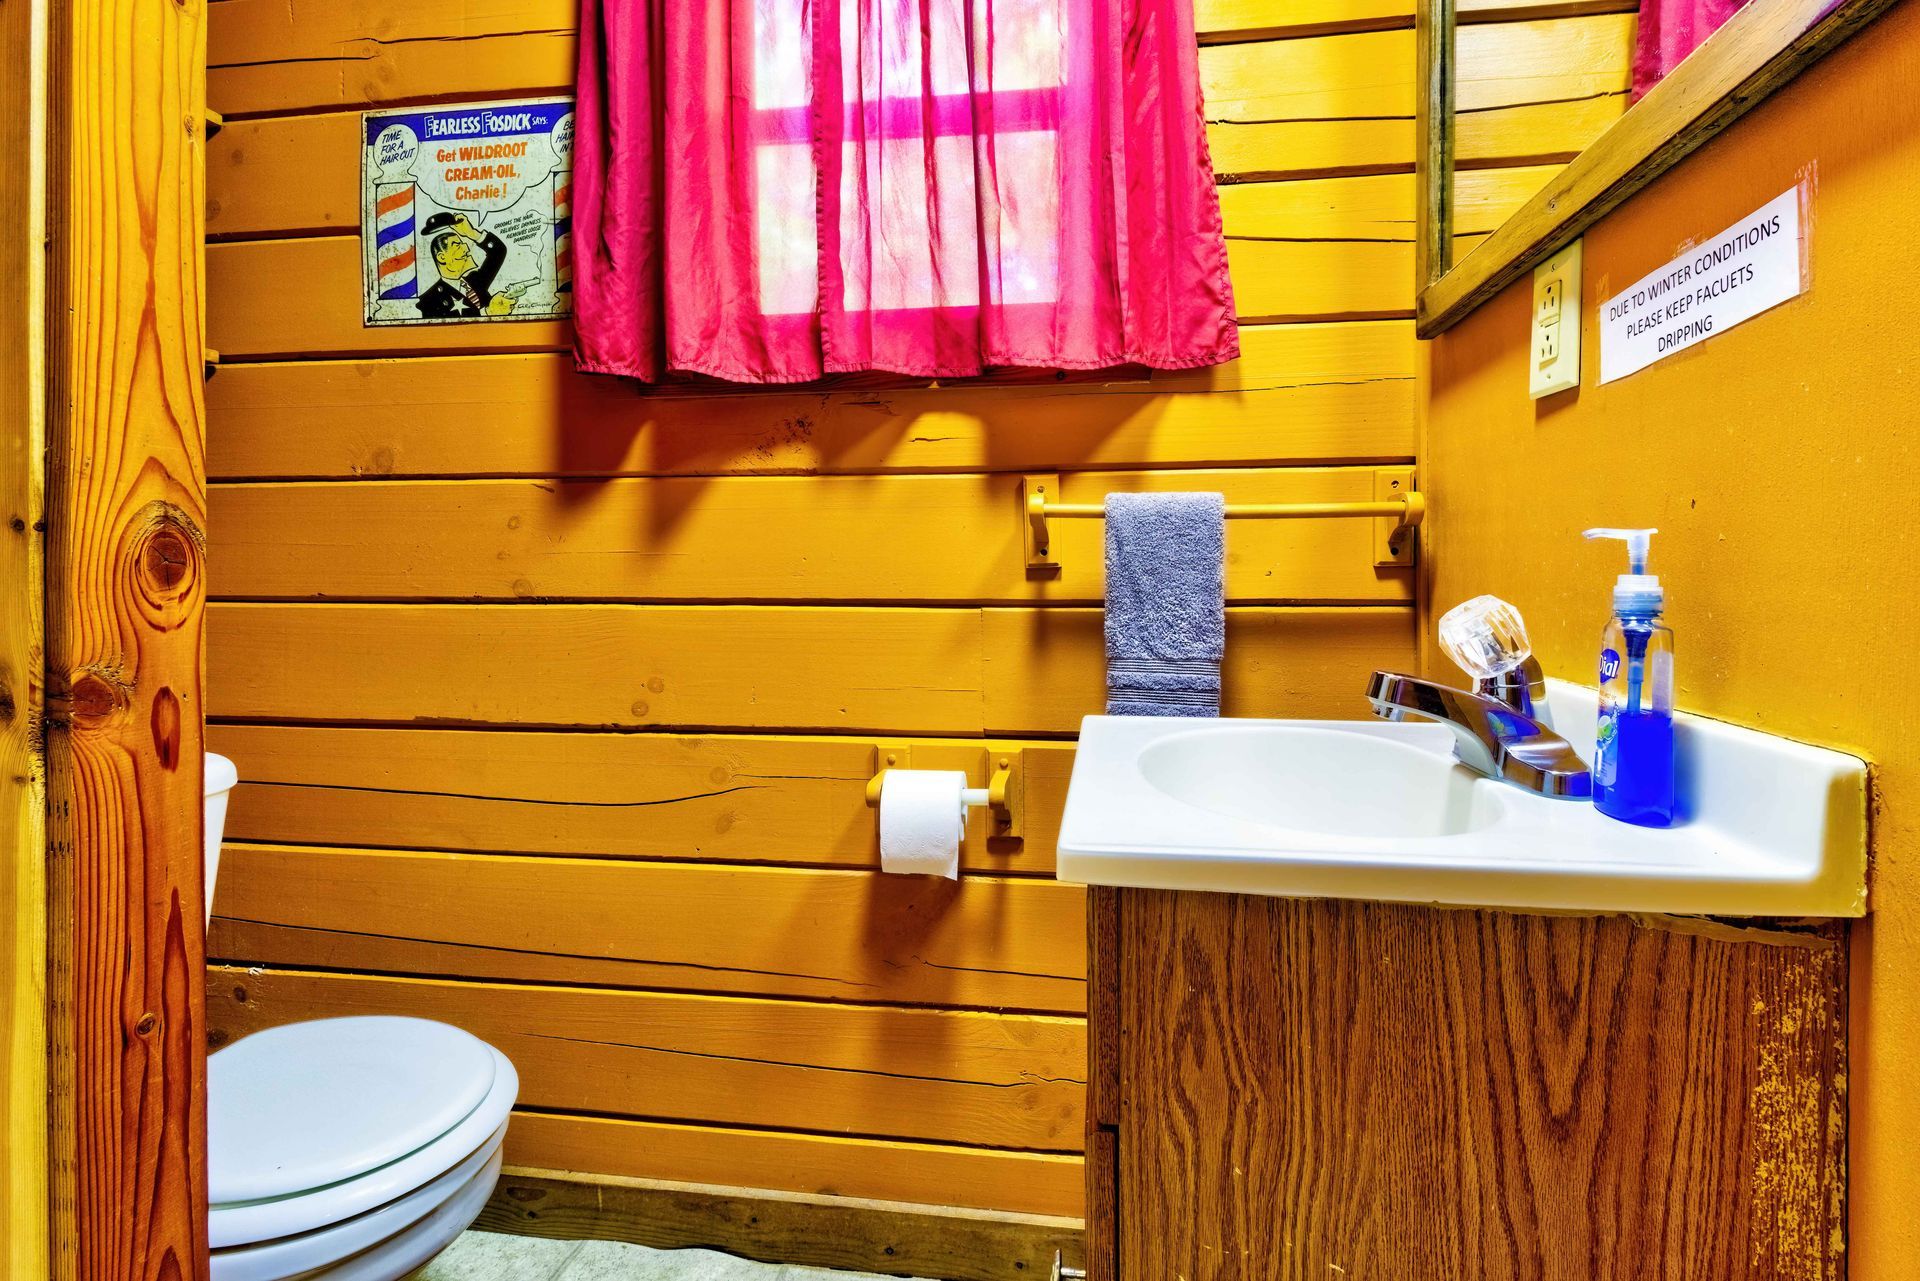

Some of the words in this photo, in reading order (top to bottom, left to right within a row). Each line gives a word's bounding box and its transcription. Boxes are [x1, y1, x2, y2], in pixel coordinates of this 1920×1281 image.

[424, 115, 481, 138] FEARLESS
[481, 111, 532, 135] FOSDICK
[382, 130, 402, 144] TIME
[381, 144, 398, 155] FOR
[397, 140, 404, 151] A
[436, 149, 457, 163] Get
[459, 141, 529, 162] WILDROOT
[380, 153, 399, 166] HAIR
[400, 148, 416, 161] CUT
[500, 224, 520, 234] RELIEVES
[506, 228, 528, 239] REMOVES
[513, 232, 537, 243] DANDRUFF
[1610, 300, 1630, 322] DUE
[1632, 291, 1645, 310] TO
[1647, 265, 1691, 301] WINTER
[1694, 215, 1780, 275] CONDITIONS
[1627, 309, 1663, 339] PLEASE
[1665, 294, 1693, 321] KEEP
[1696, 263, 1754, 306] FACUETS
[1658, 315, 1713, 353] DRIPPING
